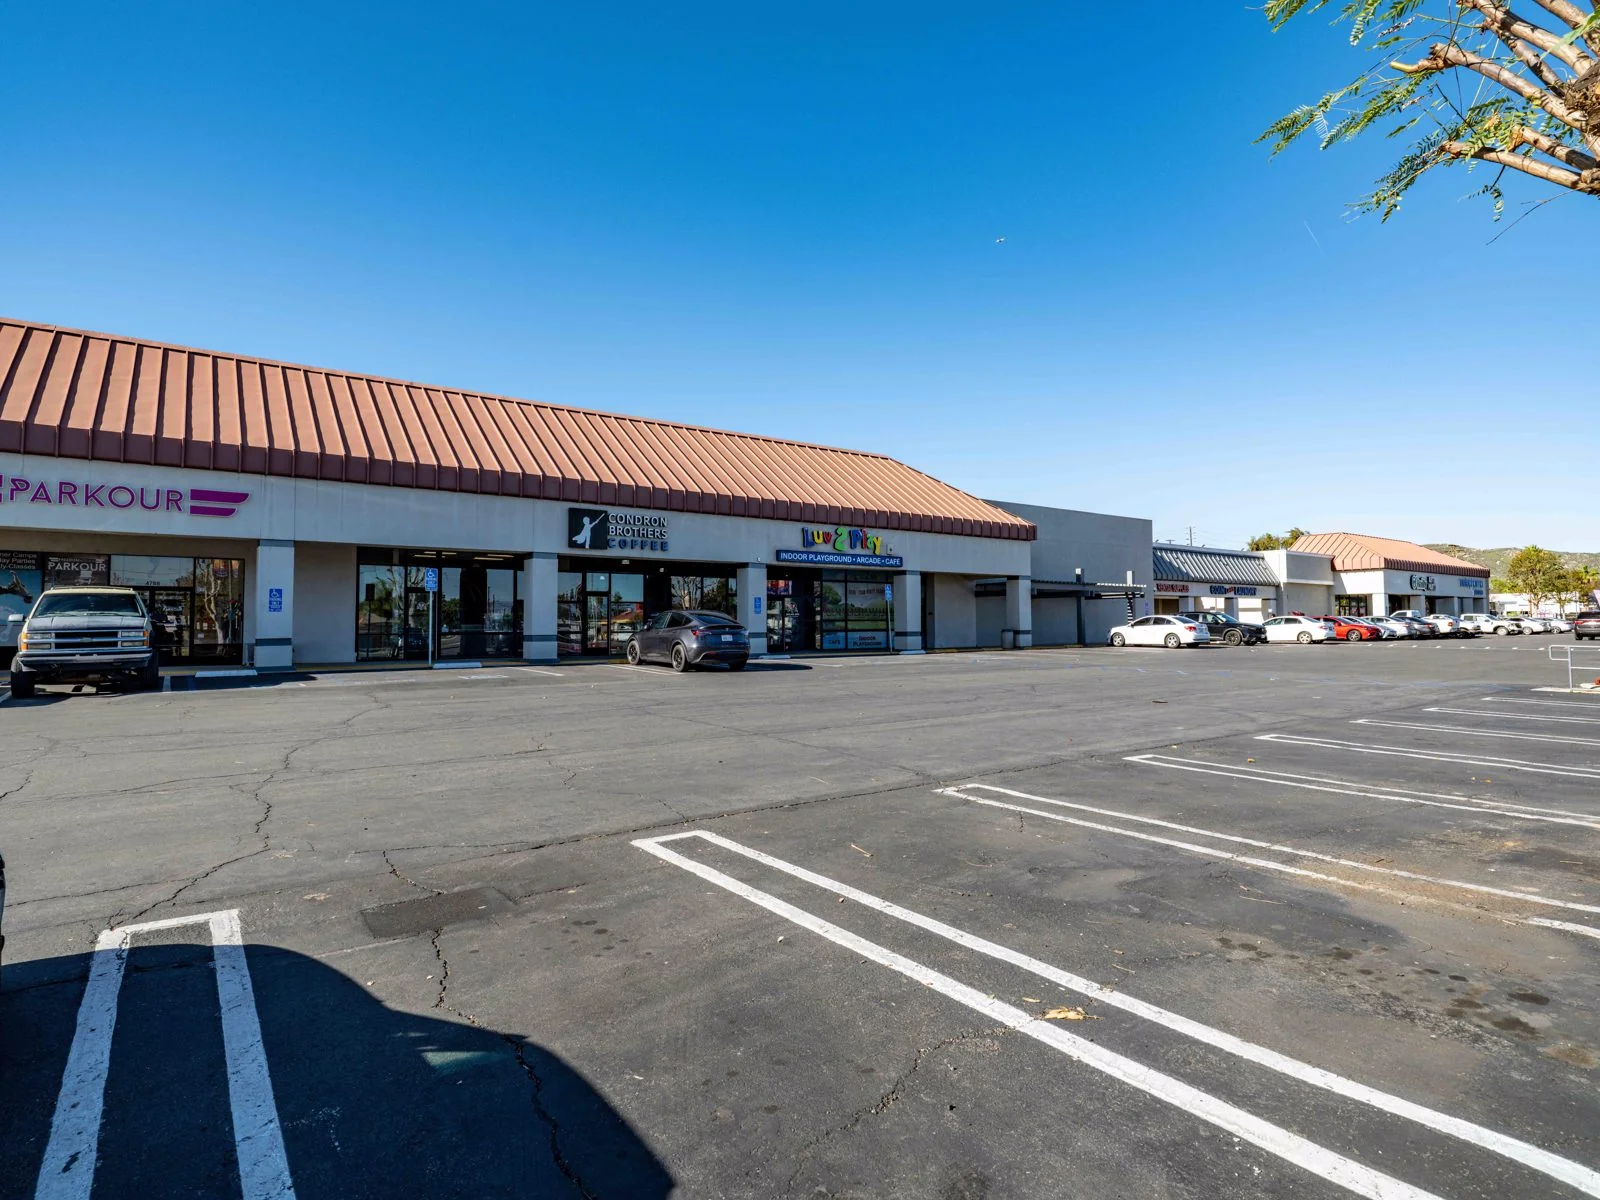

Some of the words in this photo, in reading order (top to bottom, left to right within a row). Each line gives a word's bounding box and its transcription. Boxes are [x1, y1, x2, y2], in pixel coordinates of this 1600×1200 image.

[9, 477, 184, 512] PARKOUR
[608, 513, 667, 527] CONDRON
[608, 525, 668, 539] BROTHERS
[607, 538, 669, 552] COFFEE
[833, 526, 848, 552] 2
[849, 527, 882, 555] Play
[780, 552, 808, 561] INDOOR
[808, 553, 852, 564] PLAYGROUND
[48, 562, 106, 572] PARKOUR
